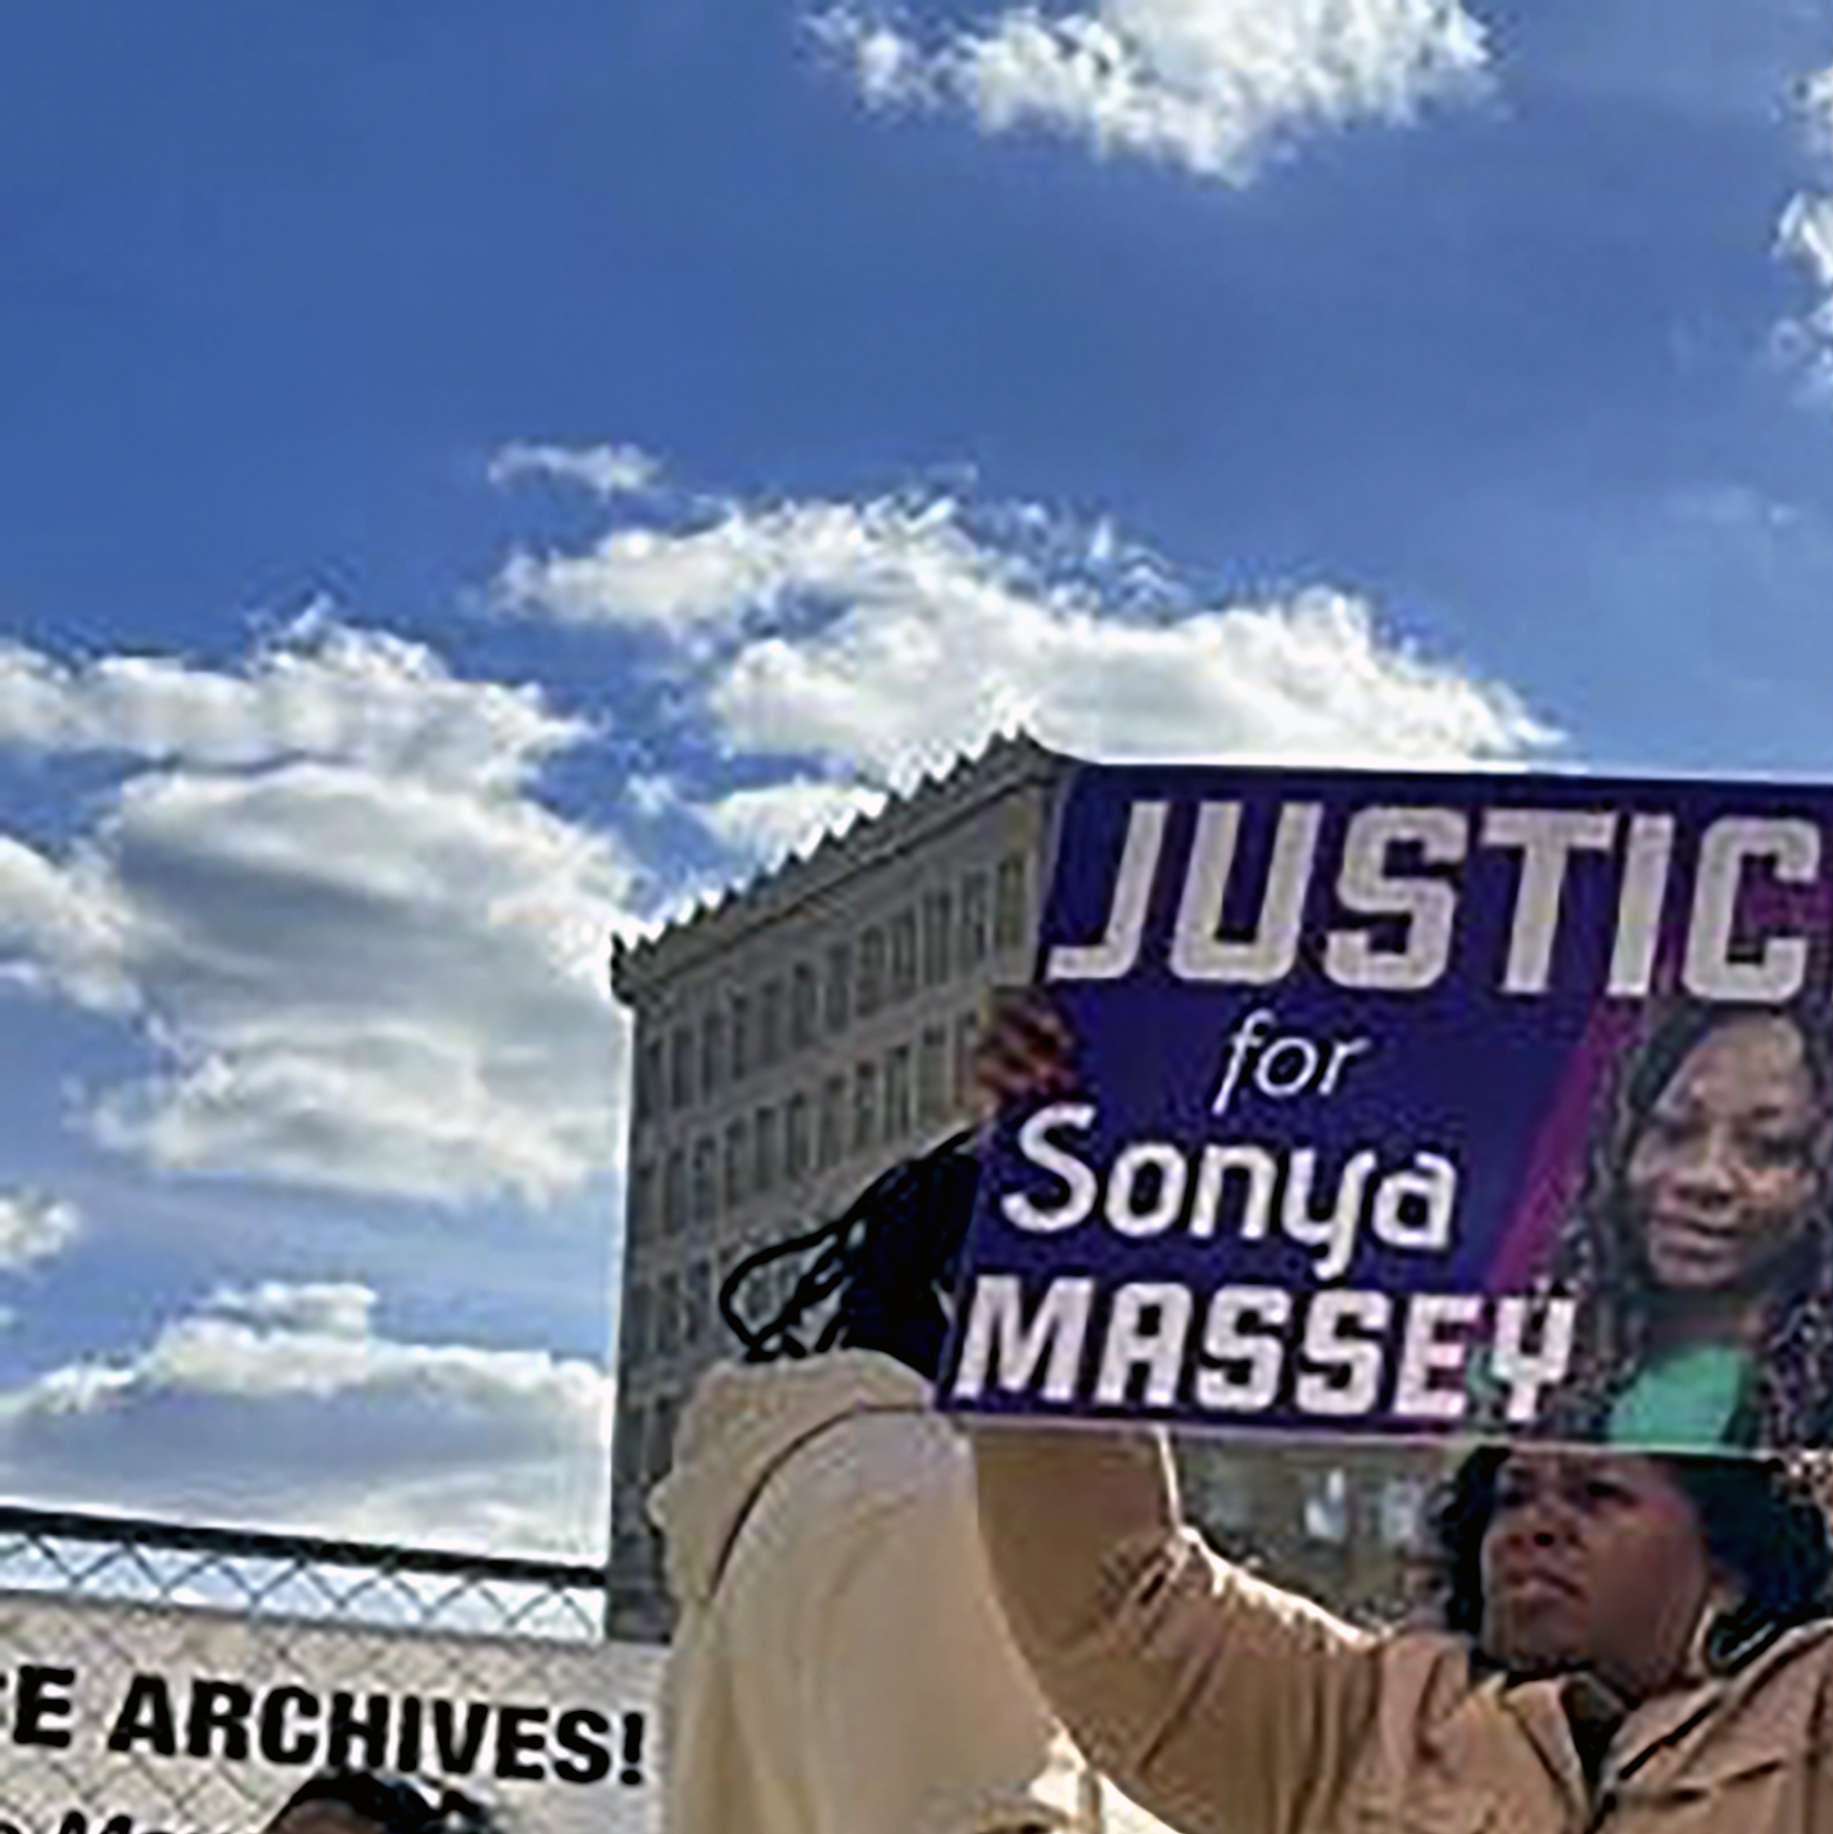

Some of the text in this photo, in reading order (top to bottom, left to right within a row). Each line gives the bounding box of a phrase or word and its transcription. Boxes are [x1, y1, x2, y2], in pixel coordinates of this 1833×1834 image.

[1212, 1009, 1369, 1115] for
[1002, 1105, 1456, 1280] Sonya
[953, 1274, 1577, 1421] MASSEY
[108, 1674, 645, 1786] ARCHIVES!
